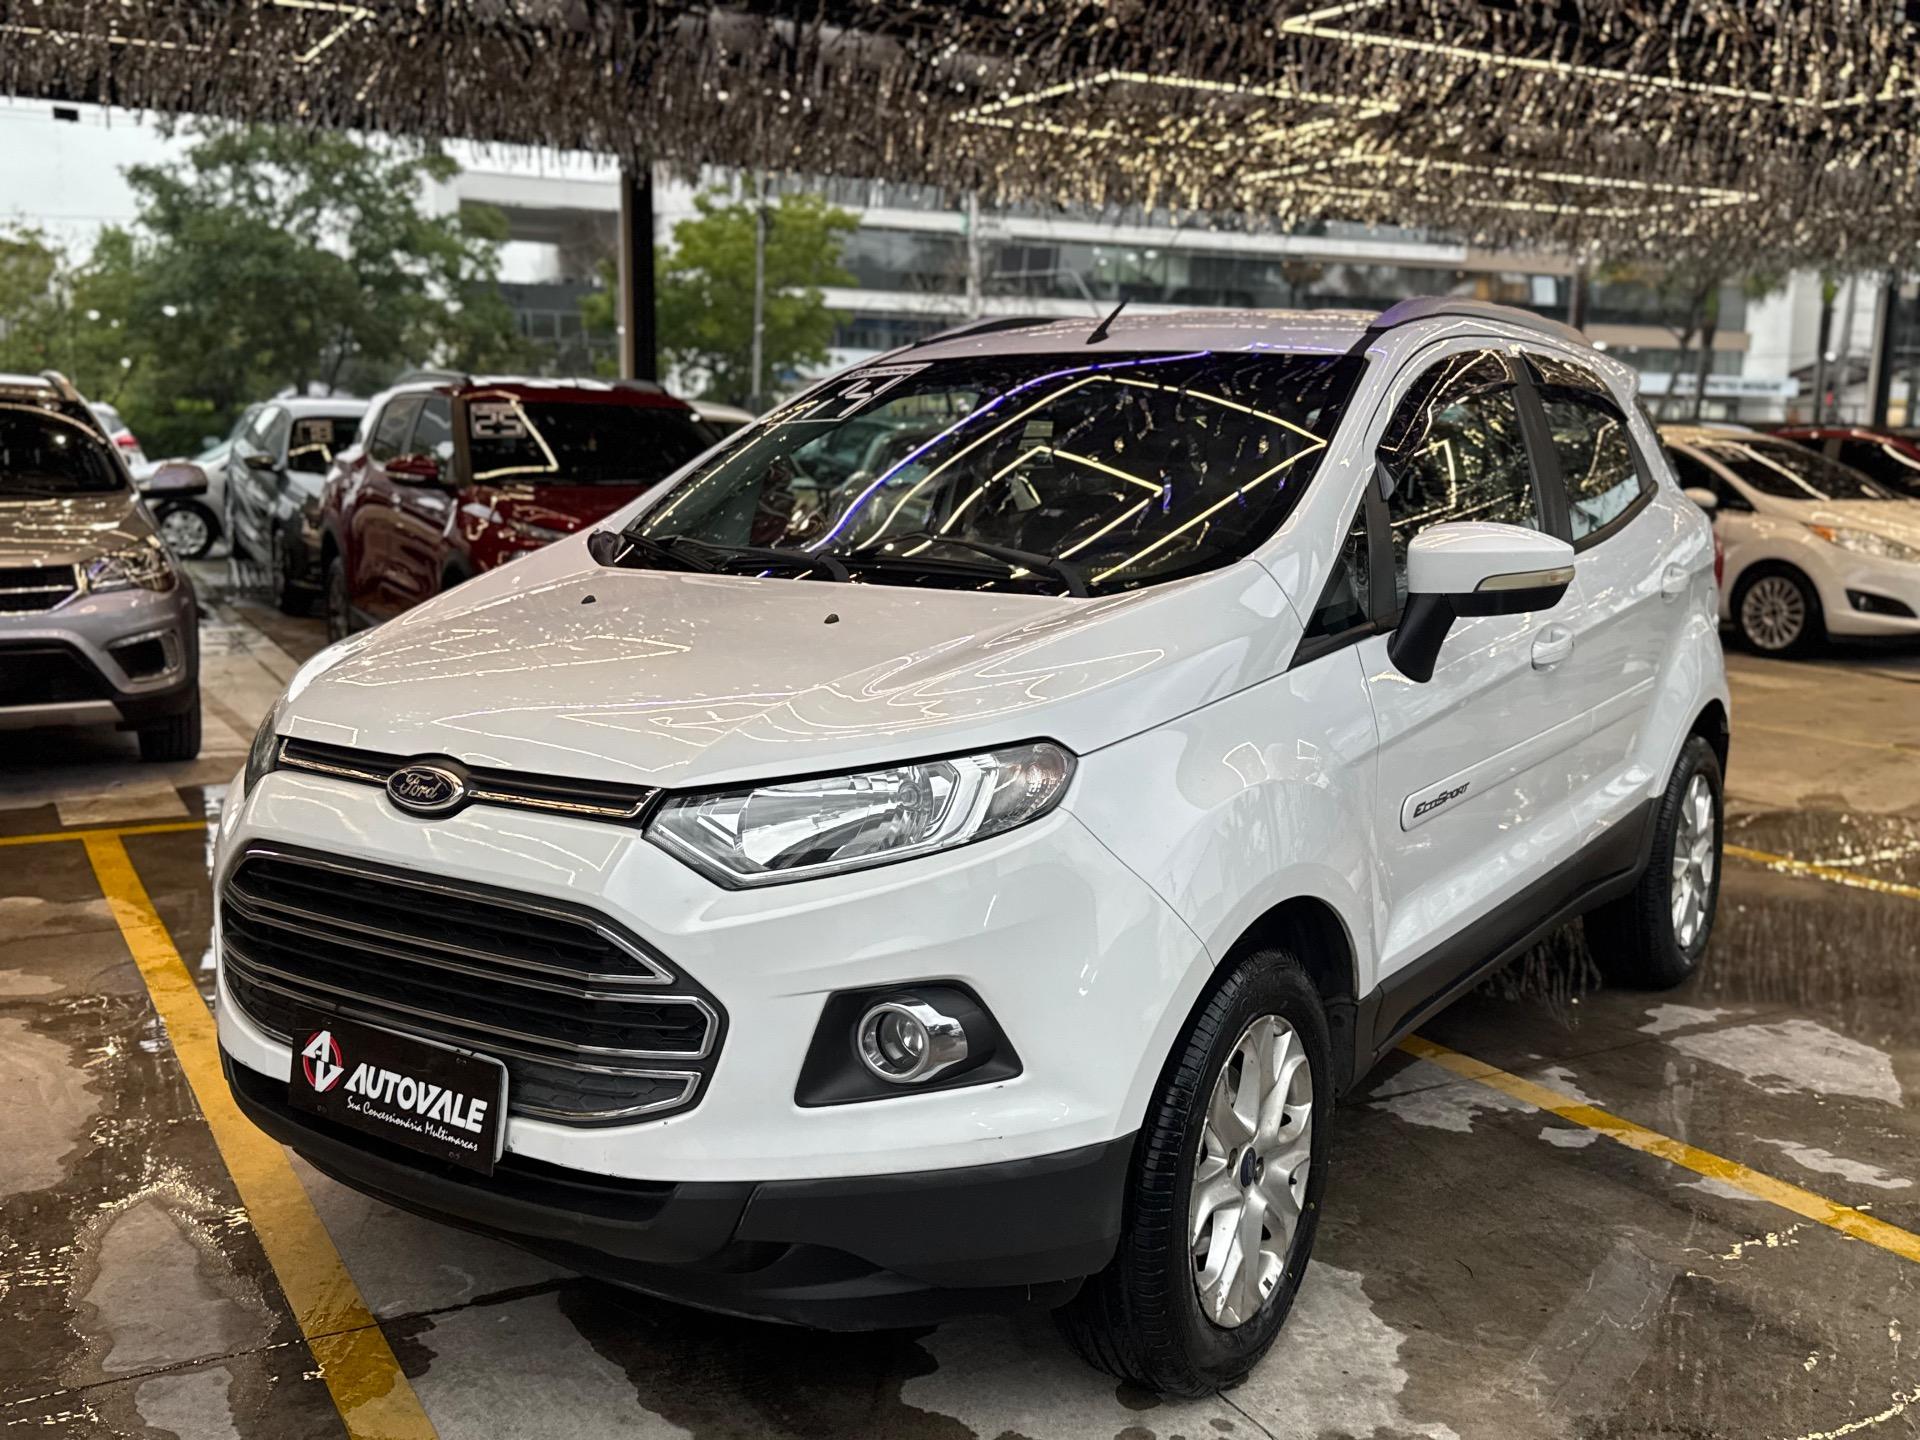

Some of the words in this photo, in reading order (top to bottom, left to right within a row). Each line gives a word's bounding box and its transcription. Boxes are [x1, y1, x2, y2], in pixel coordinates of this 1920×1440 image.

[395, 773, 444, 799] Ford
[343, 1062, 489, 1134] AUTOVALE
[347, 1095, 362, 1112] Sua
[362, 1101, 422, 1133] Concessionária
[424, 1120, 479, 1152] Multimarcas
